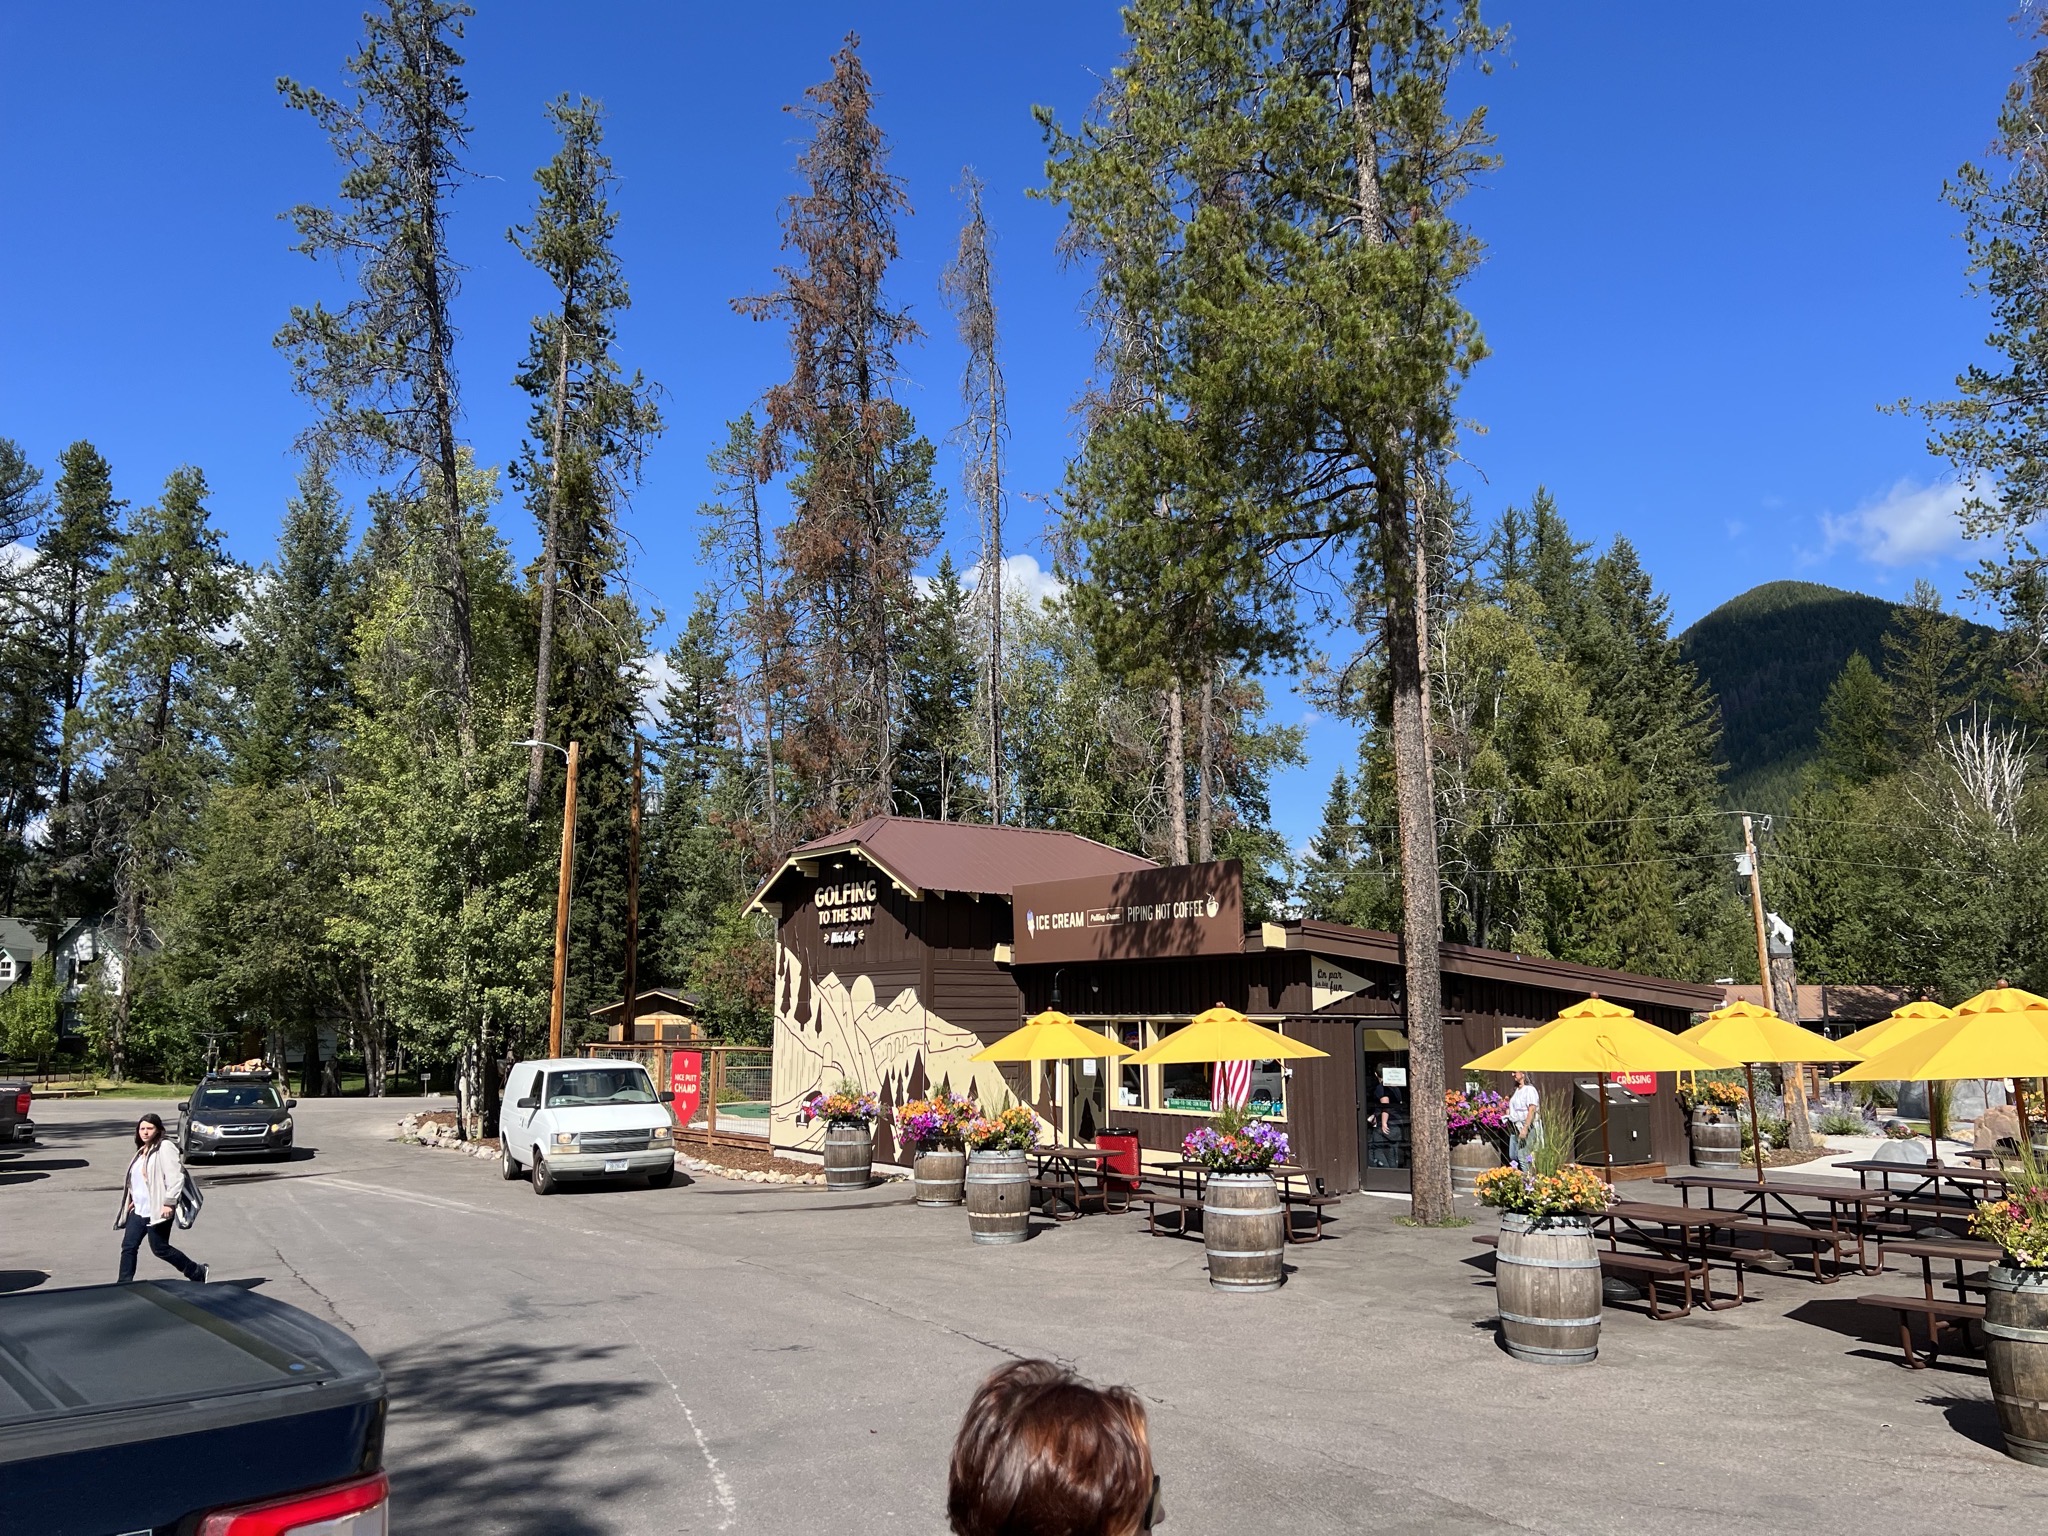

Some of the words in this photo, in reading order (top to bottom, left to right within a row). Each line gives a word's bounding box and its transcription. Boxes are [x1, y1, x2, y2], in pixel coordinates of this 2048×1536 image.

[814, 880, 877, 908] GOLFING
[818, 910, 830, 925] TO
[832, 908, 849, 923] THE
[851, 906, 871, 921] SUN
[1127, 904, 1153, 923] PIPING
[1155, 902, 1171, 920] HOT
[1173, 899, 1204, 919] COFFEE
[1036, 914, 1050, 931] ICE
[1051, 912, 1084, 929] CREAM
[1317, 968, 1327, 979] On
[1328, 971, 1343, 981] par
[1330, 980, 1344, 995] fun
[674, 1073, 685, 1081] NICE
[685, 1074, 697, 1082] PUTT
[674, 1082, 697, 1094] CHAMP
